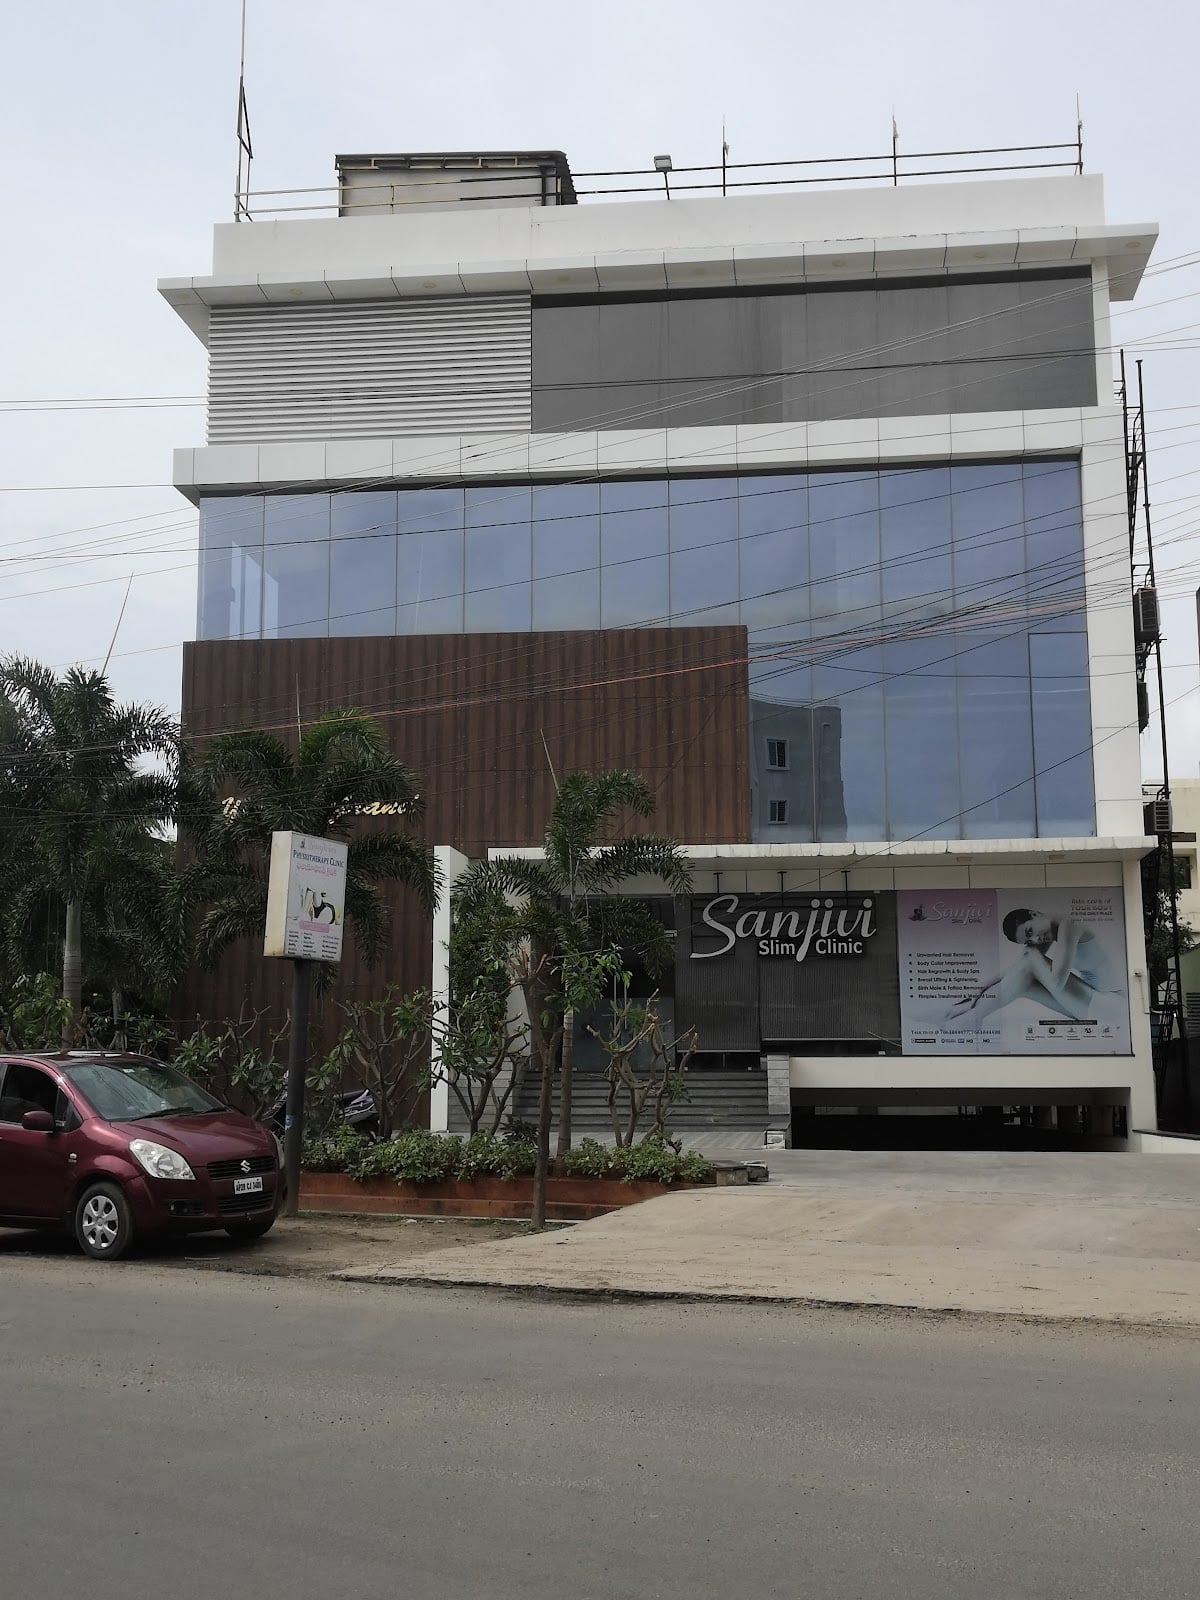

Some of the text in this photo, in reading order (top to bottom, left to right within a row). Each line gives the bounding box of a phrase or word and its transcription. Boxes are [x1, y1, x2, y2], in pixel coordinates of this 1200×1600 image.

[329, 857, 345, 868] CLINIC
[926, 901, 993, 925] Sanjivi
[690, 894, 877, 962] Sanjivi
[758, 938, 863, 955] Slim Clinic
